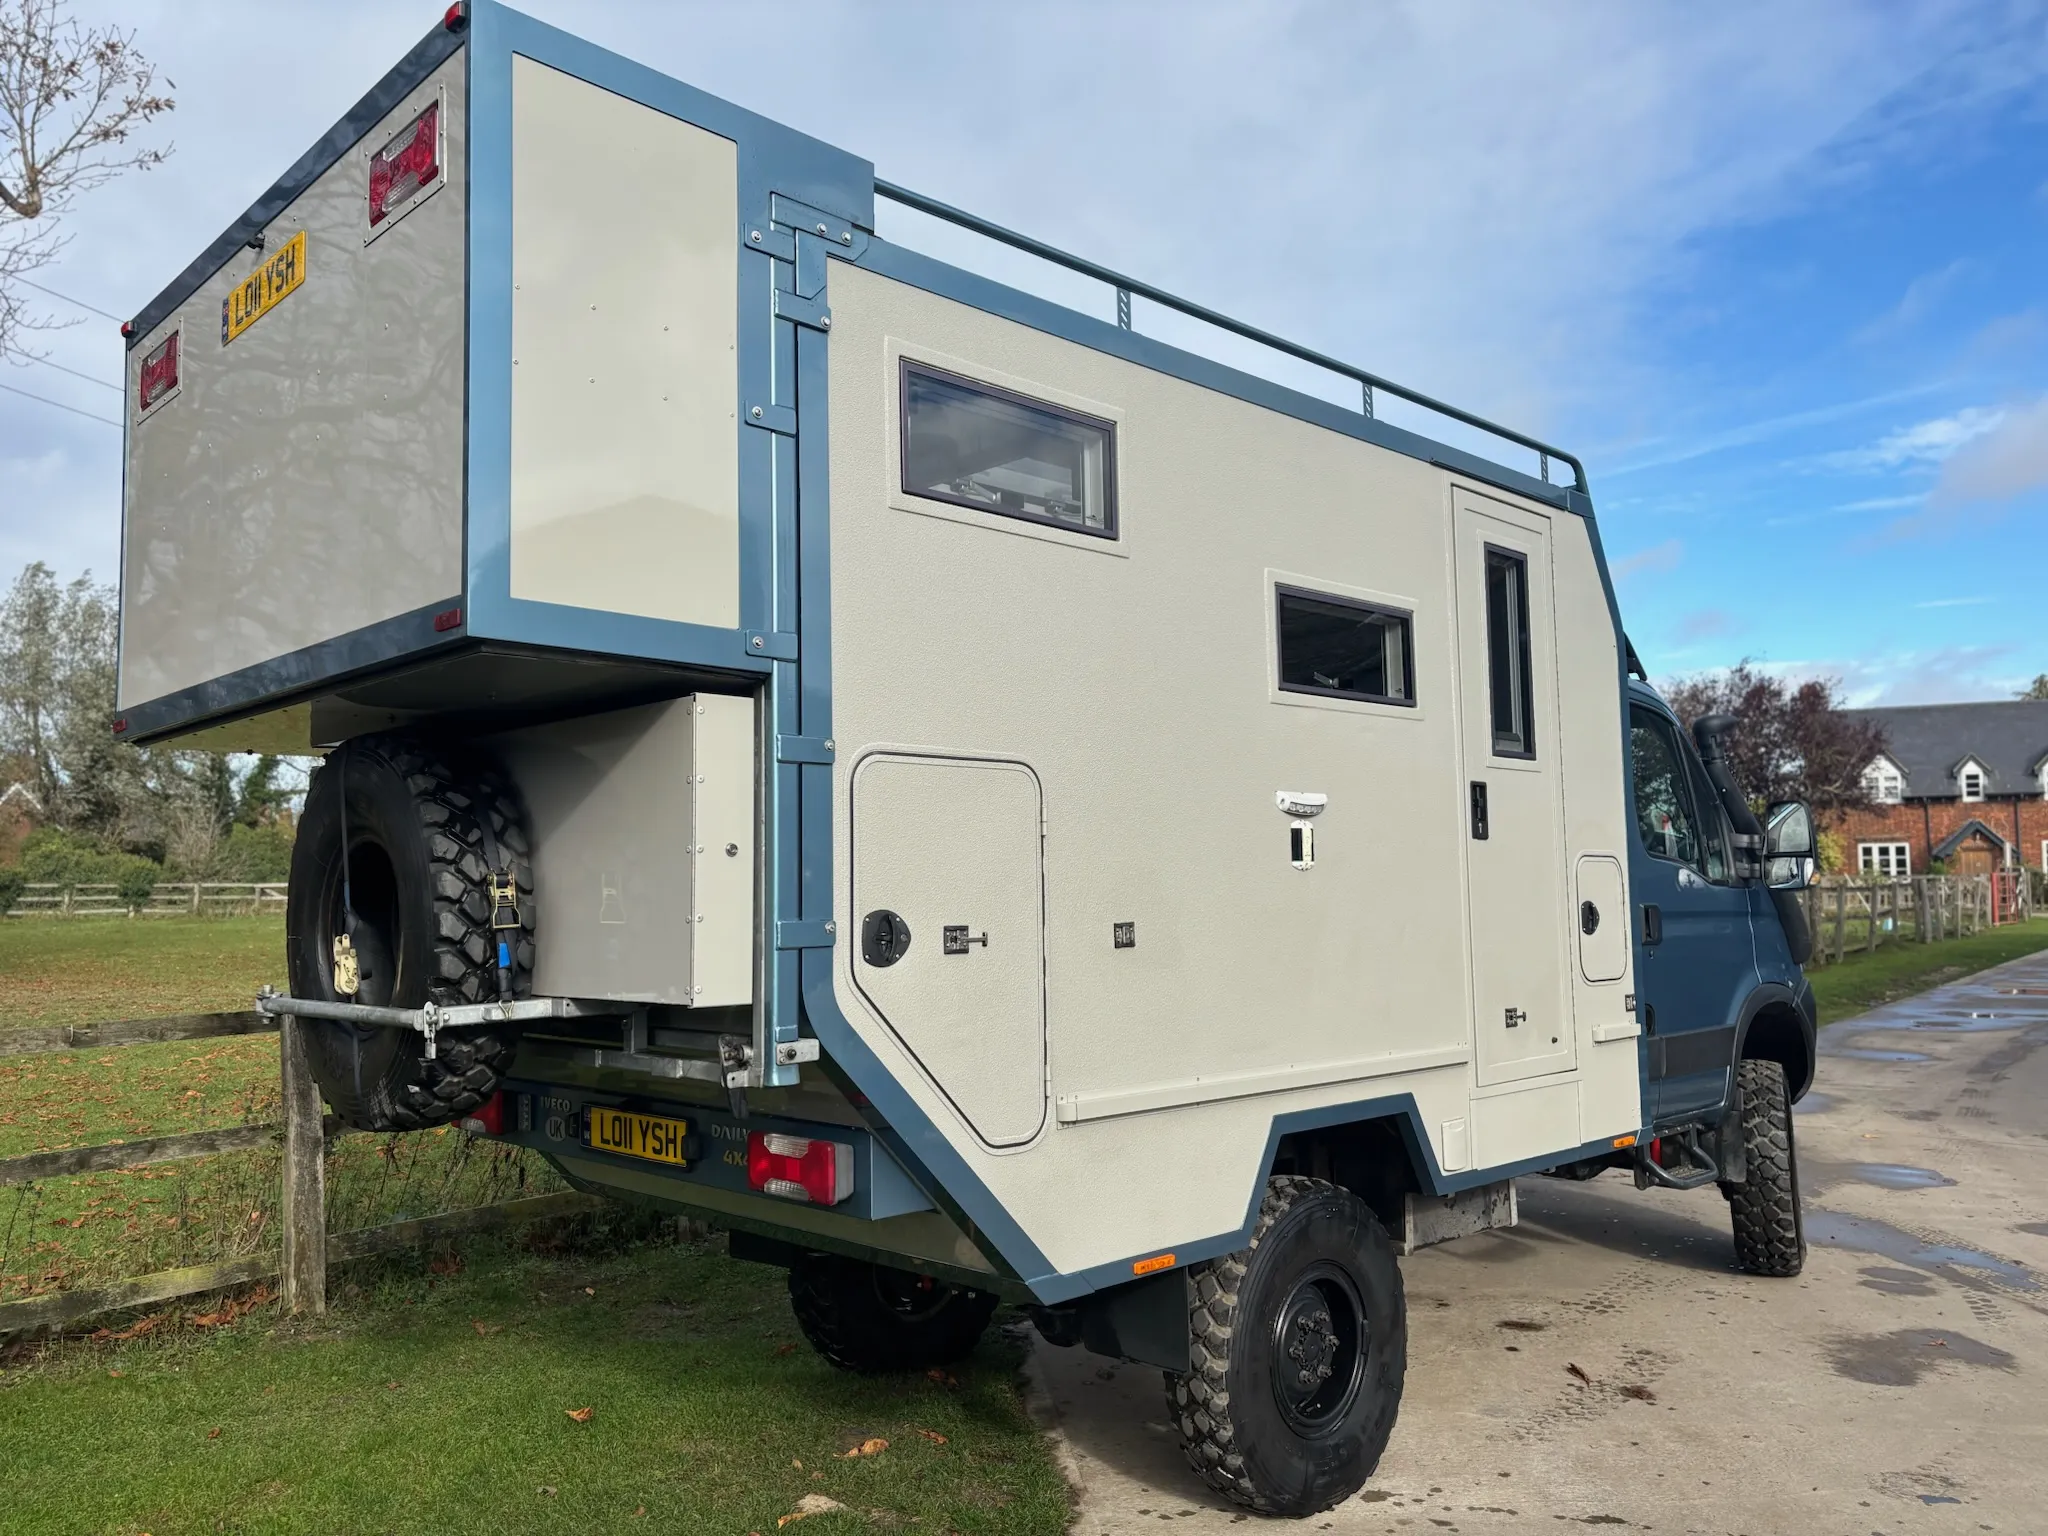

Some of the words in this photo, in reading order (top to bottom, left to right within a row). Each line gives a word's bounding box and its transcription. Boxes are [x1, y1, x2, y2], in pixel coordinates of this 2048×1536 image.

[235, 274, 261, 327] LO11
[265, 243, 296, 301] YSH
[540, 1095, 571, 1113] IVECO
[549, 1119, 563, 1139] UK
[600, 1112, 633, 1151] LO11
[638, 1118, 678, 1159] YSH
